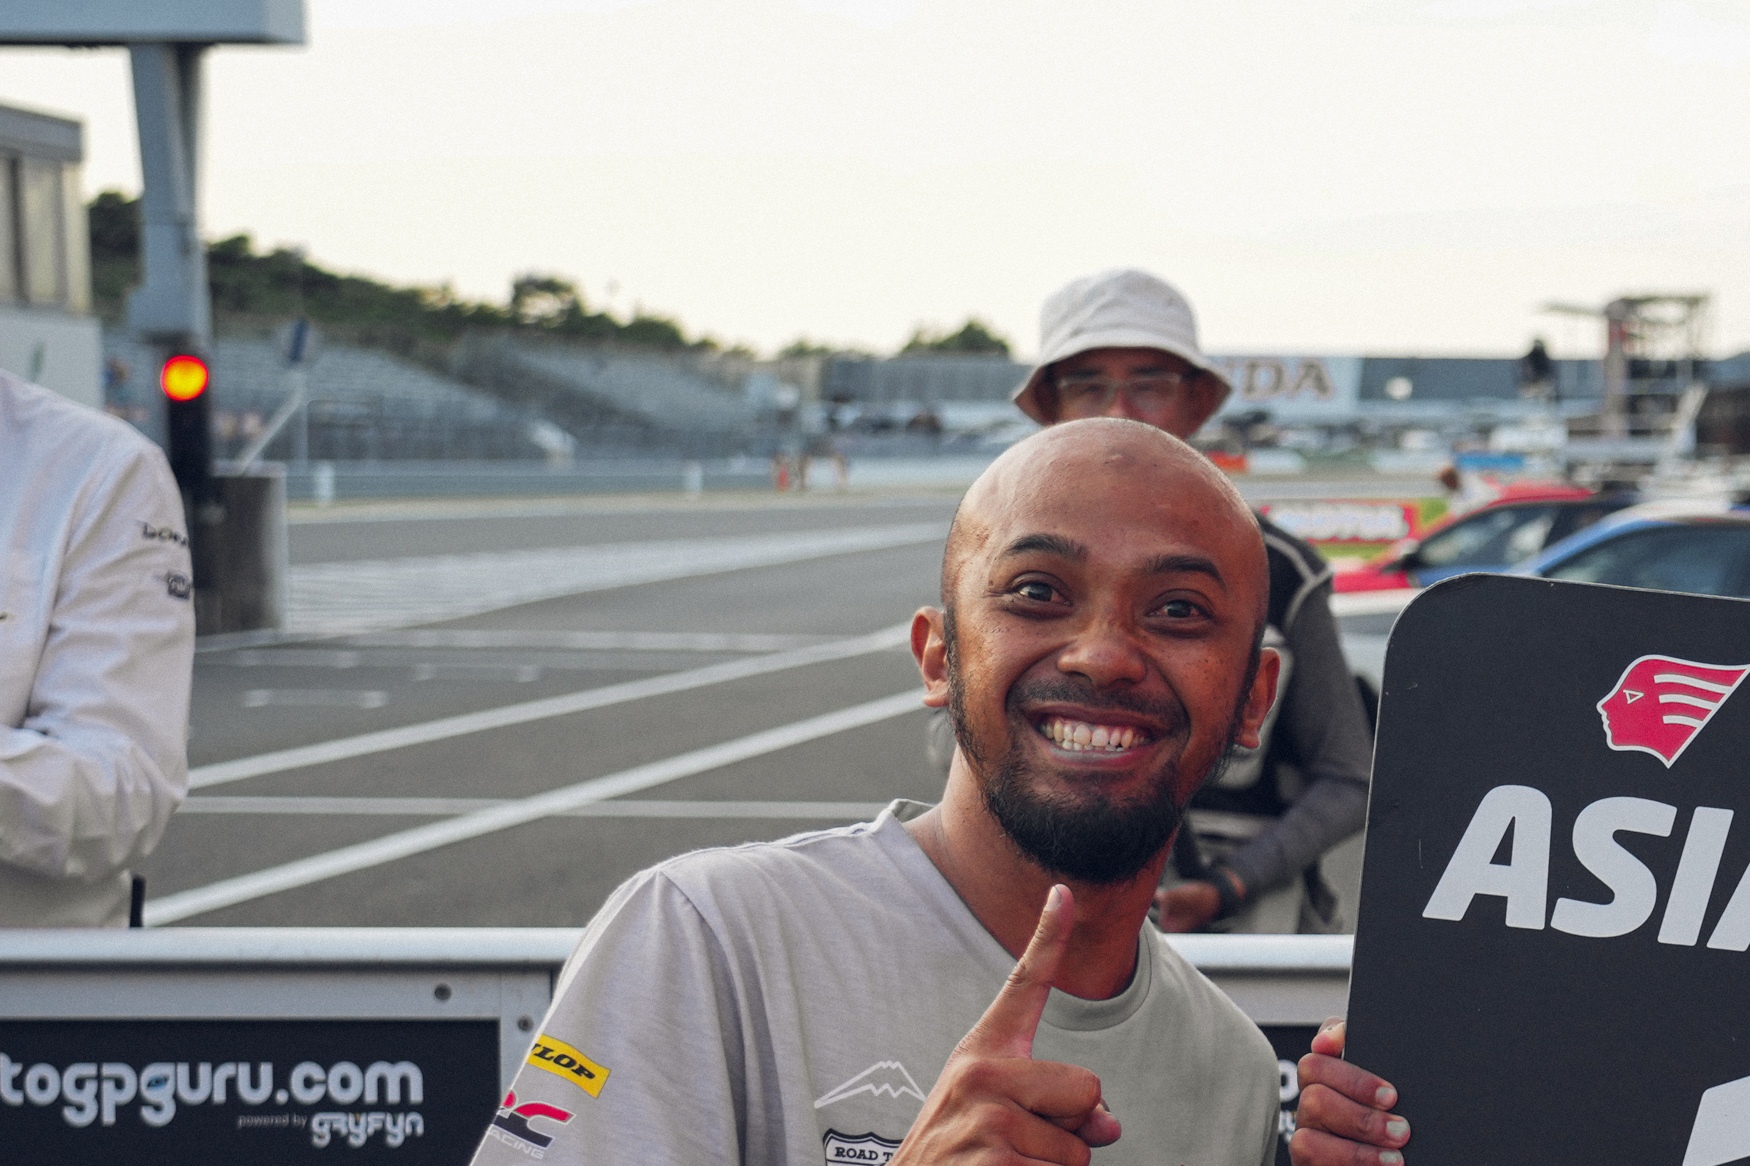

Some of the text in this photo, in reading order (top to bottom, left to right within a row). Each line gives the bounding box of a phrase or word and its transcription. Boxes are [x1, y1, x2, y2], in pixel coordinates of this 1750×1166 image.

[530, 1043, 596, 1081] LOP
[238, 1114, 290, 1128] powered
[293, 1112, 307, 1127] by
[834, 1146, 896, 1162] ROAD T
